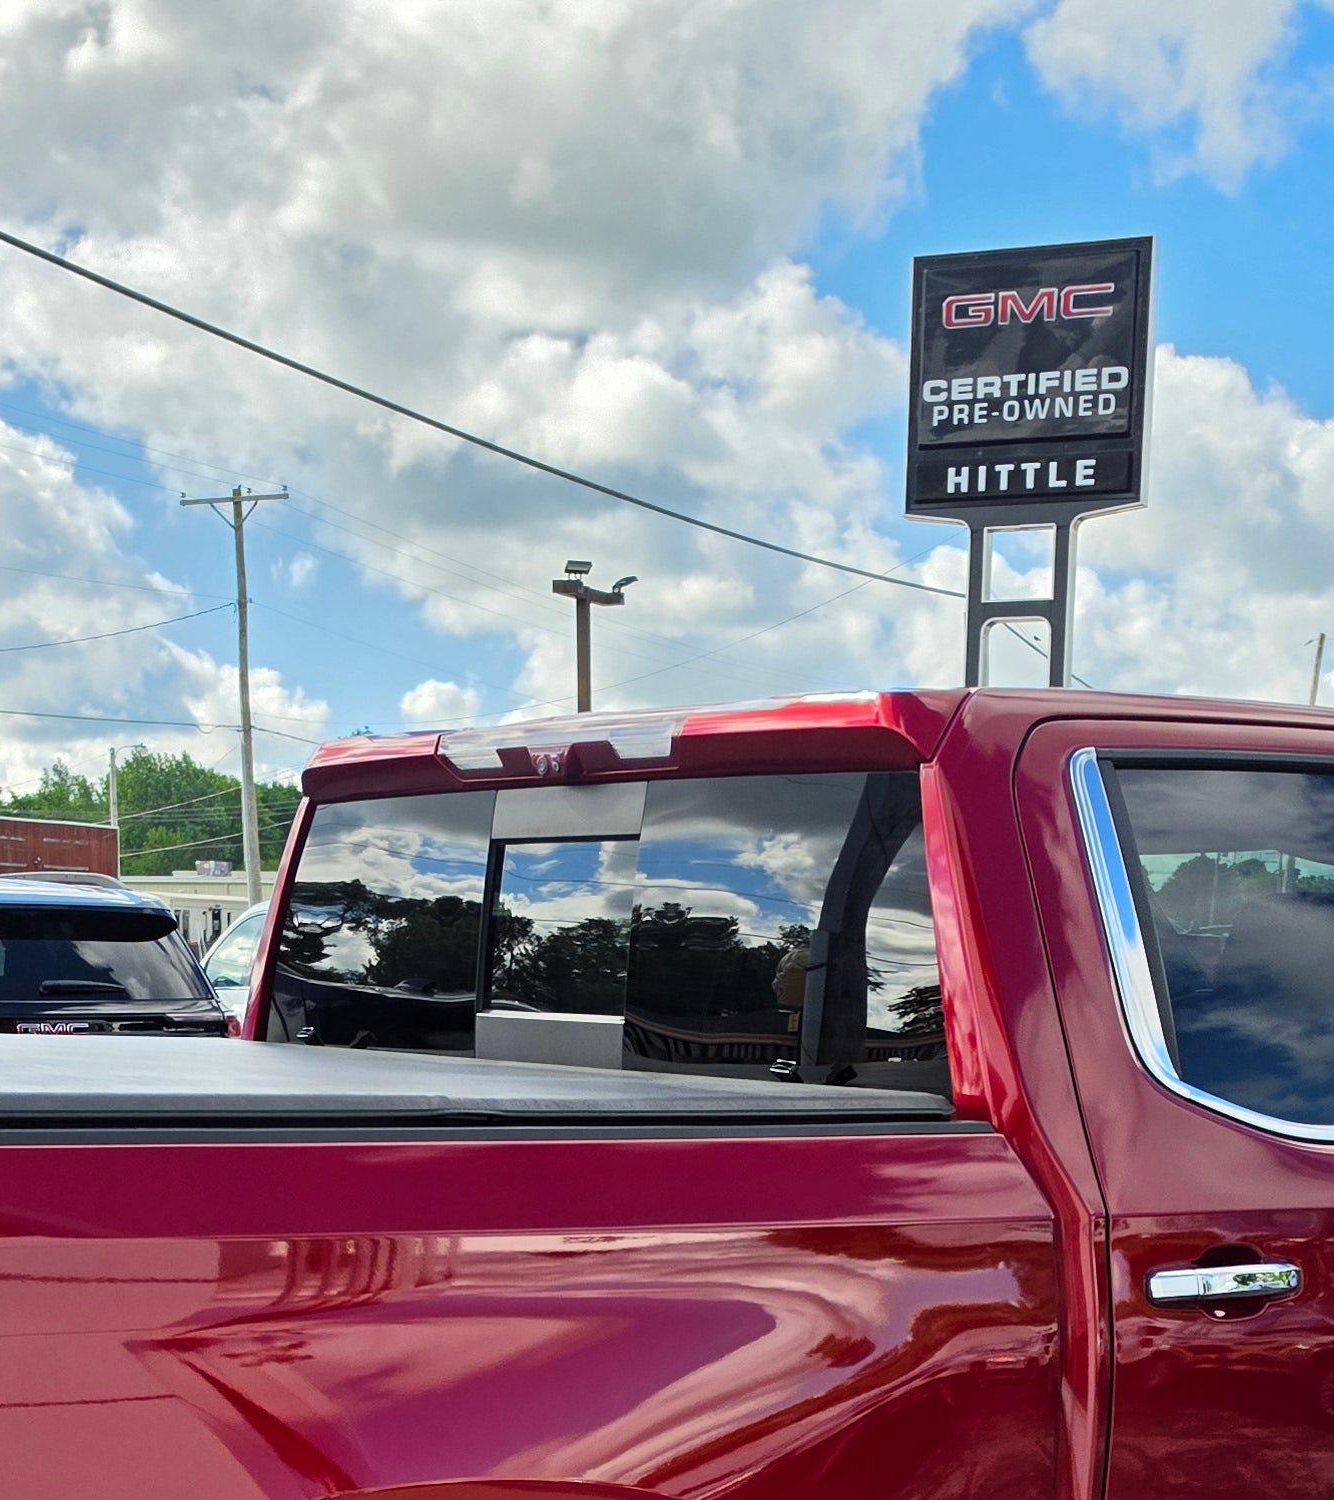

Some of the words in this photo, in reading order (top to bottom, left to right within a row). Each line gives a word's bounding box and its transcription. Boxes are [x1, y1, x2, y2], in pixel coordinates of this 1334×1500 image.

[942, 283, 1115, 330] GMC
[922, 366, 1129, 402] CERTIFIED
[932, 393, 1116, 427] PRE-OWNED
[947, 459, 1097, 494] HITTLE
